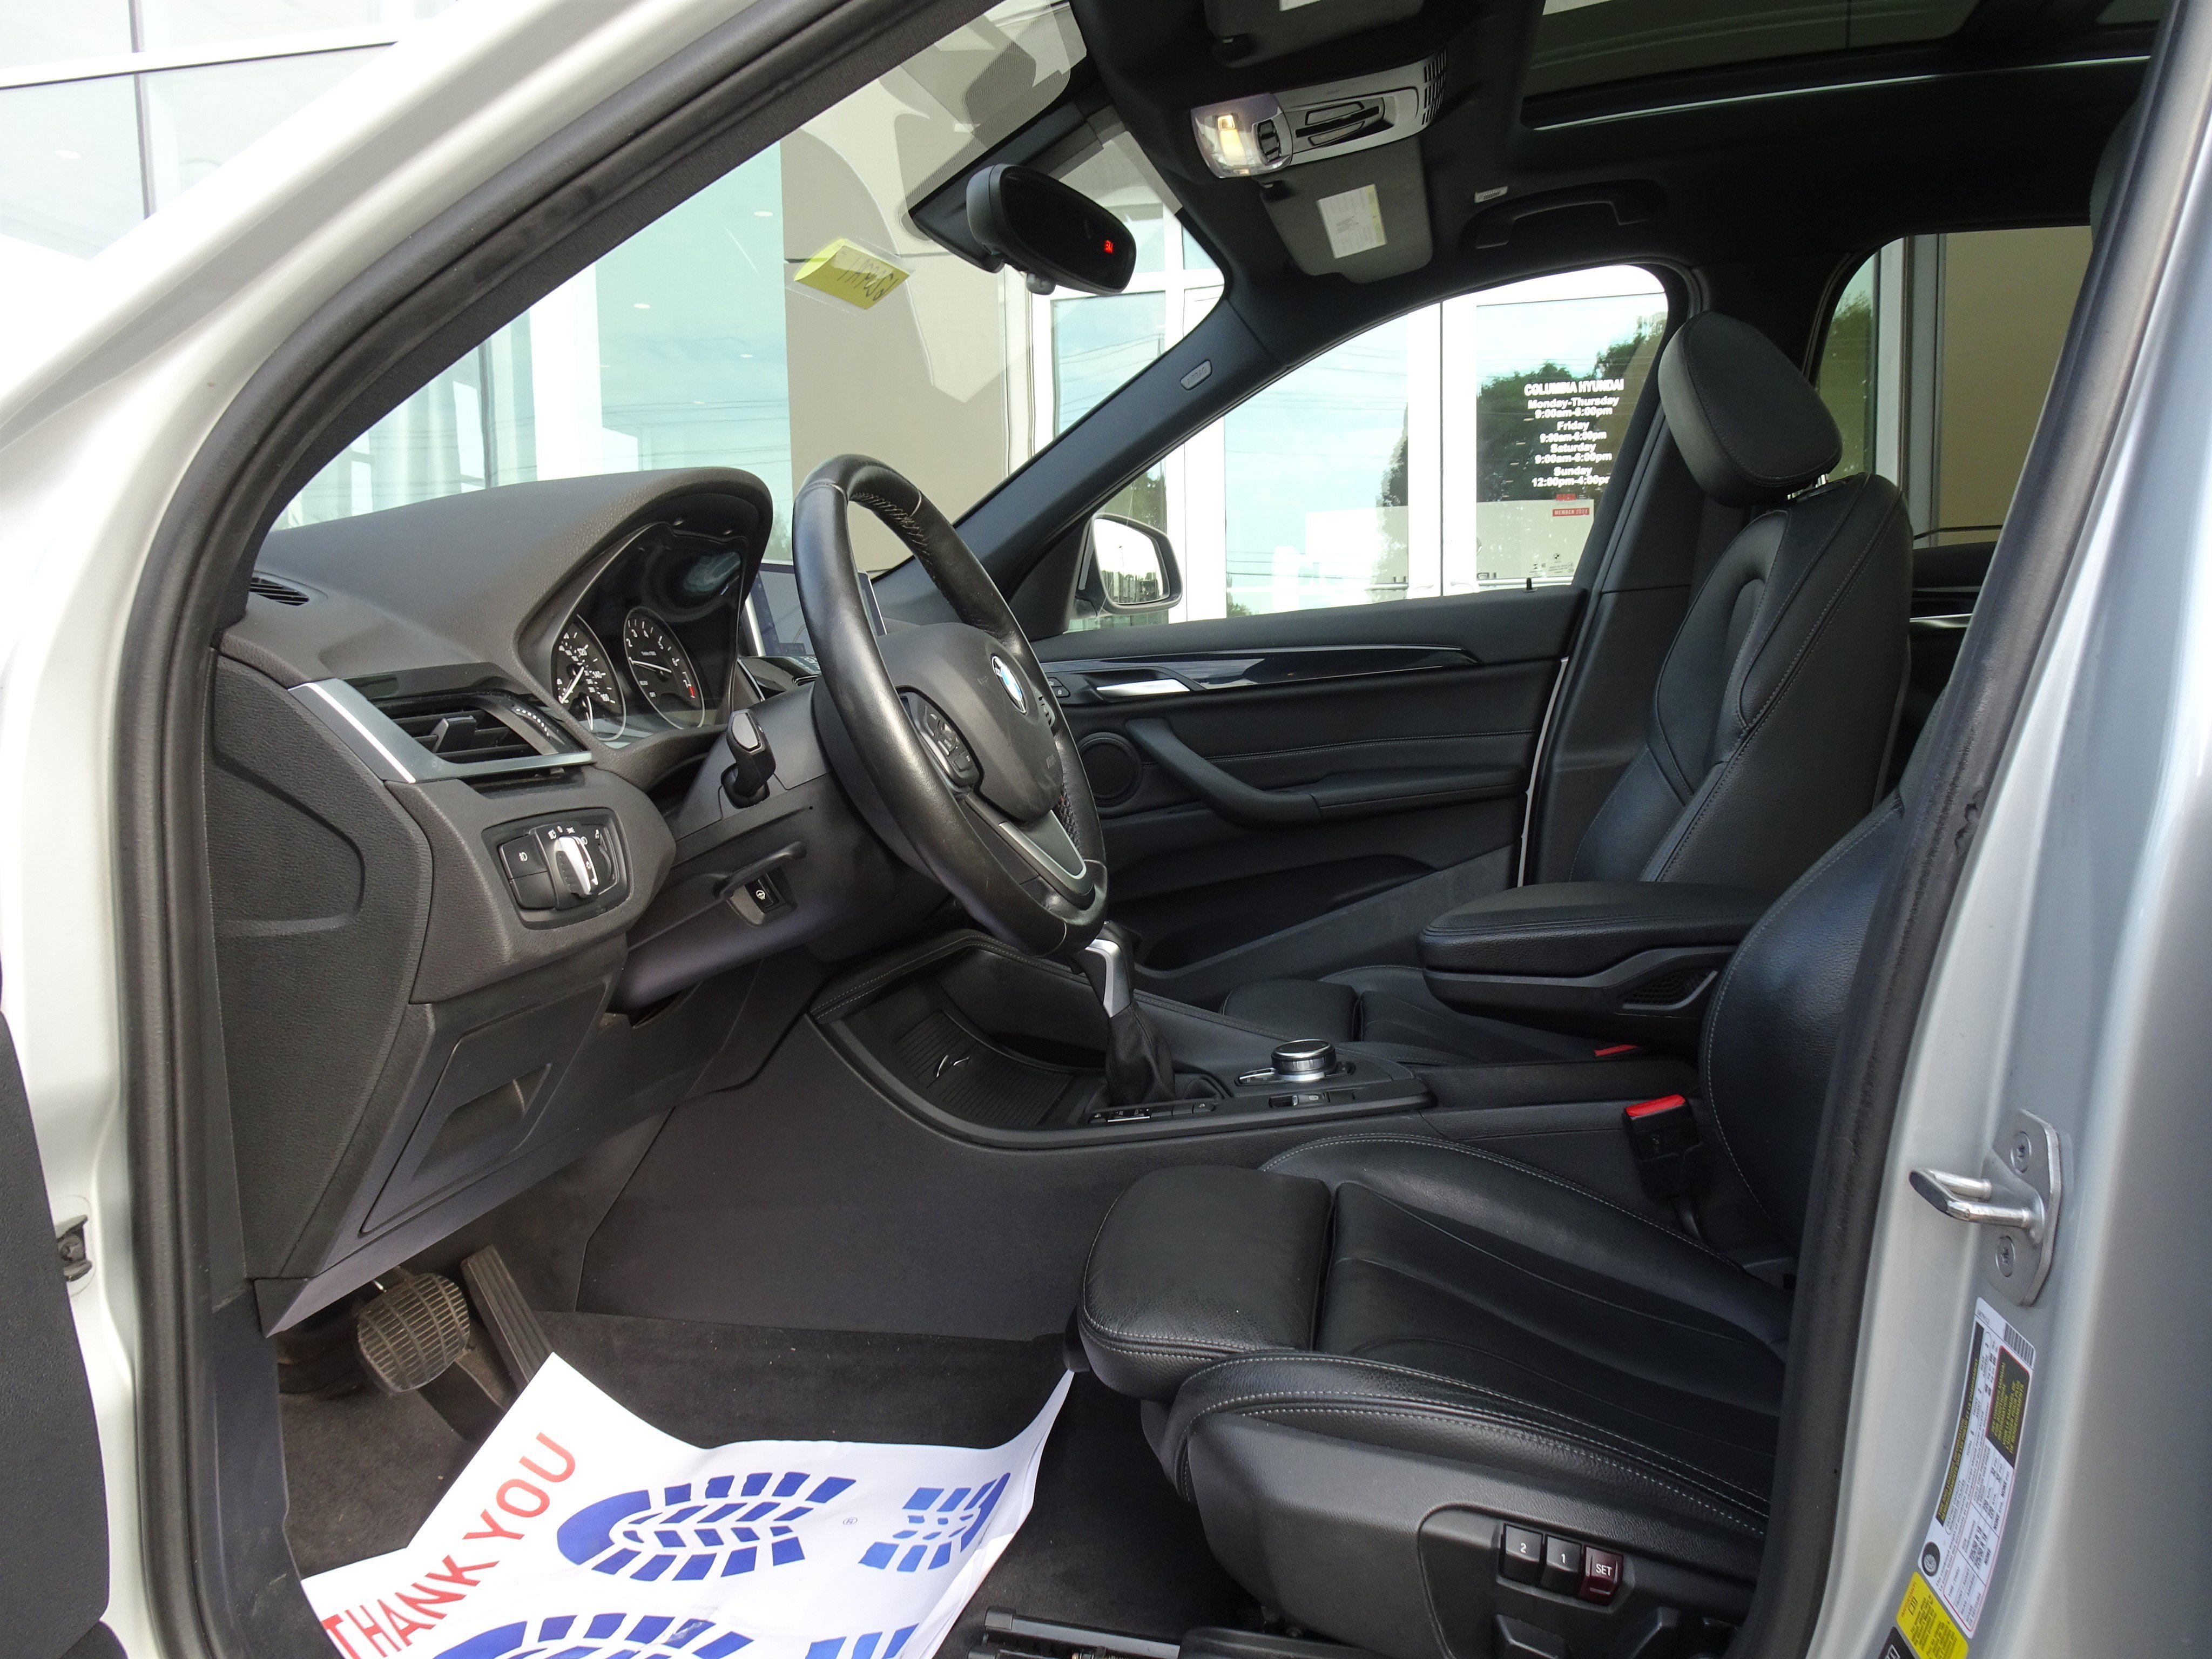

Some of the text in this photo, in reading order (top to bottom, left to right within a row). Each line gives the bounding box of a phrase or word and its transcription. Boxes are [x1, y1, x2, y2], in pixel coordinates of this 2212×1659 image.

[1524, 379, 1624, 396] COLUMBIA HYUNDAI
[1528, 395, 1620, 409] Monday-Thursday
[1557, 421, 1590, 431] Friday
[1550, 442, 1596, 453] Saturday
[1553, 466, 1593, 477] Sunday
[321, 1432, 576, 1659] THANK YOU
[1520, 1542, 1527, 1554] 2
[1561, 1553, 1566, 1564] 1
[1595, 1563, 1613, 1576] SET
